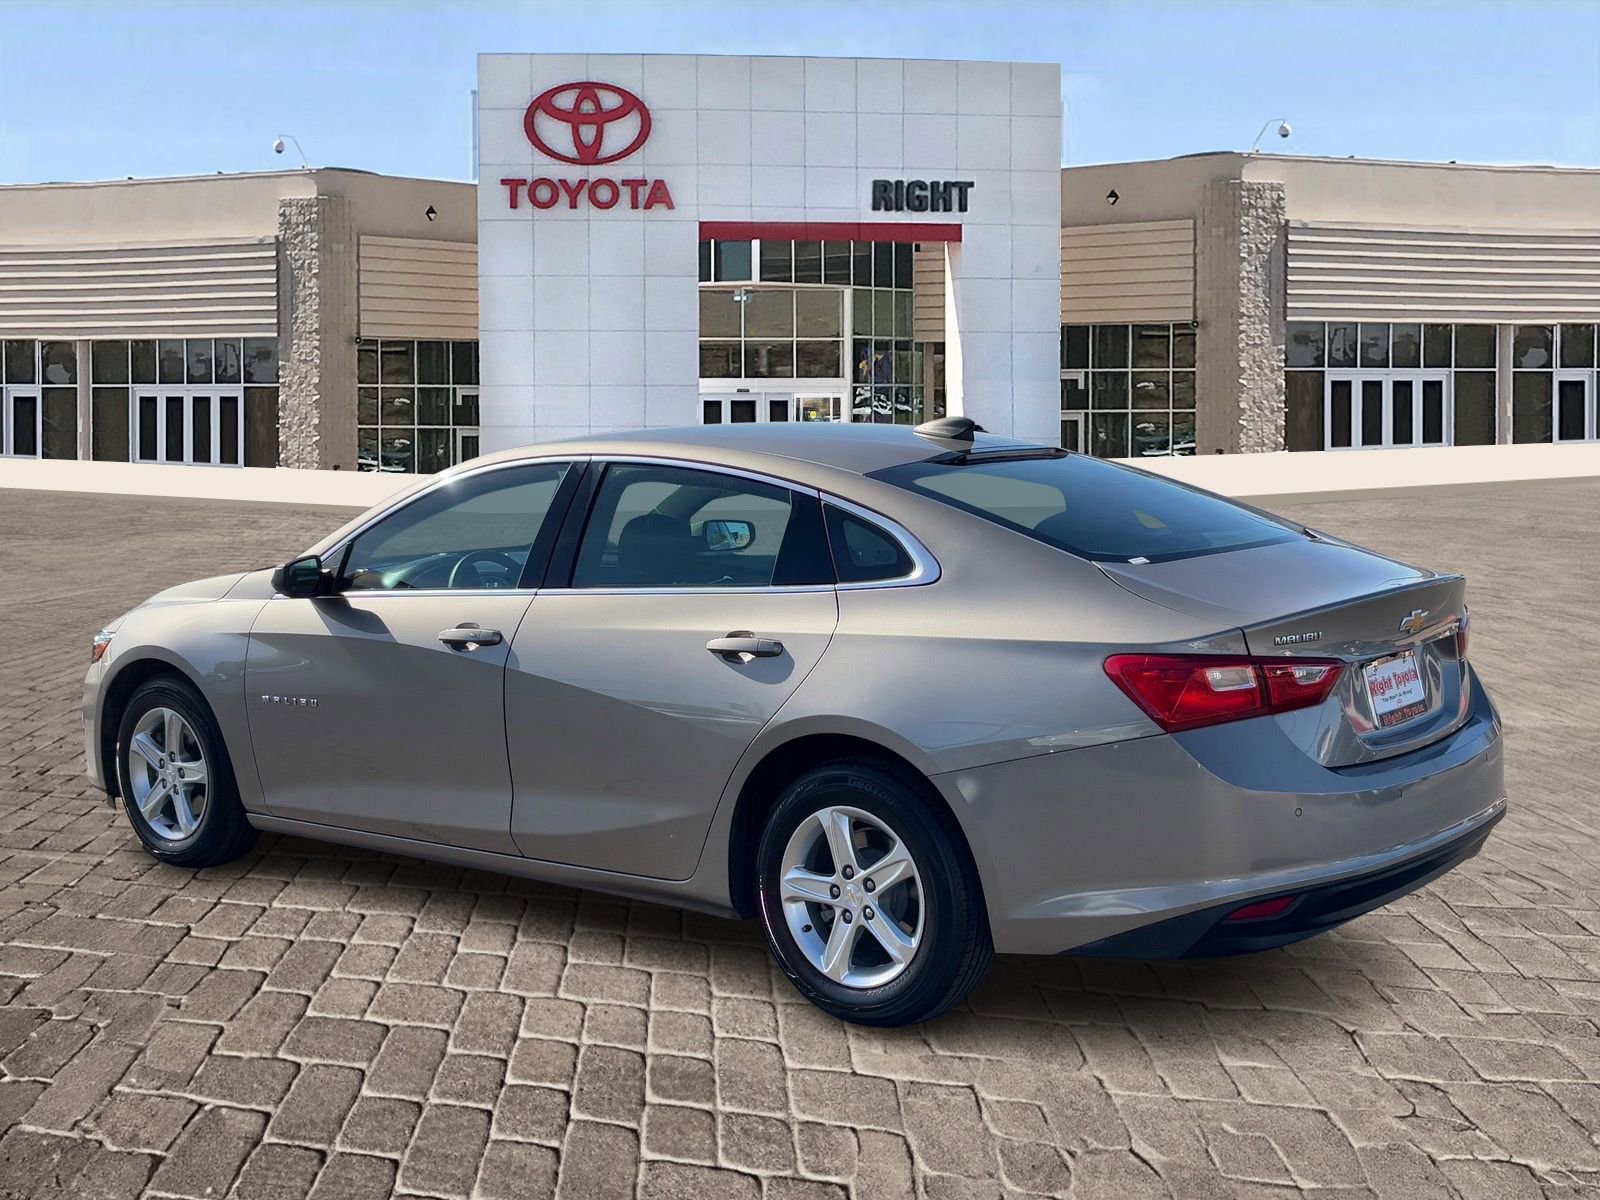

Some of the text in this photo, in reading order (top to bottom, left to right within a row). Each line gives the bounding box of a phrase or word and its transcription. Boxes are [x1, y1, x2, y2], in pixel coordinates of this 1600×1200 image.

[500, 177, 675, 211] TOYOTA
[871, 178, 975, 214] RIGHT
[1273, 631, 1322, 646] MALIBU
[1368, 668, 1418, 696] Right Toyota
[261, 694, 319, 707] MALIBU
